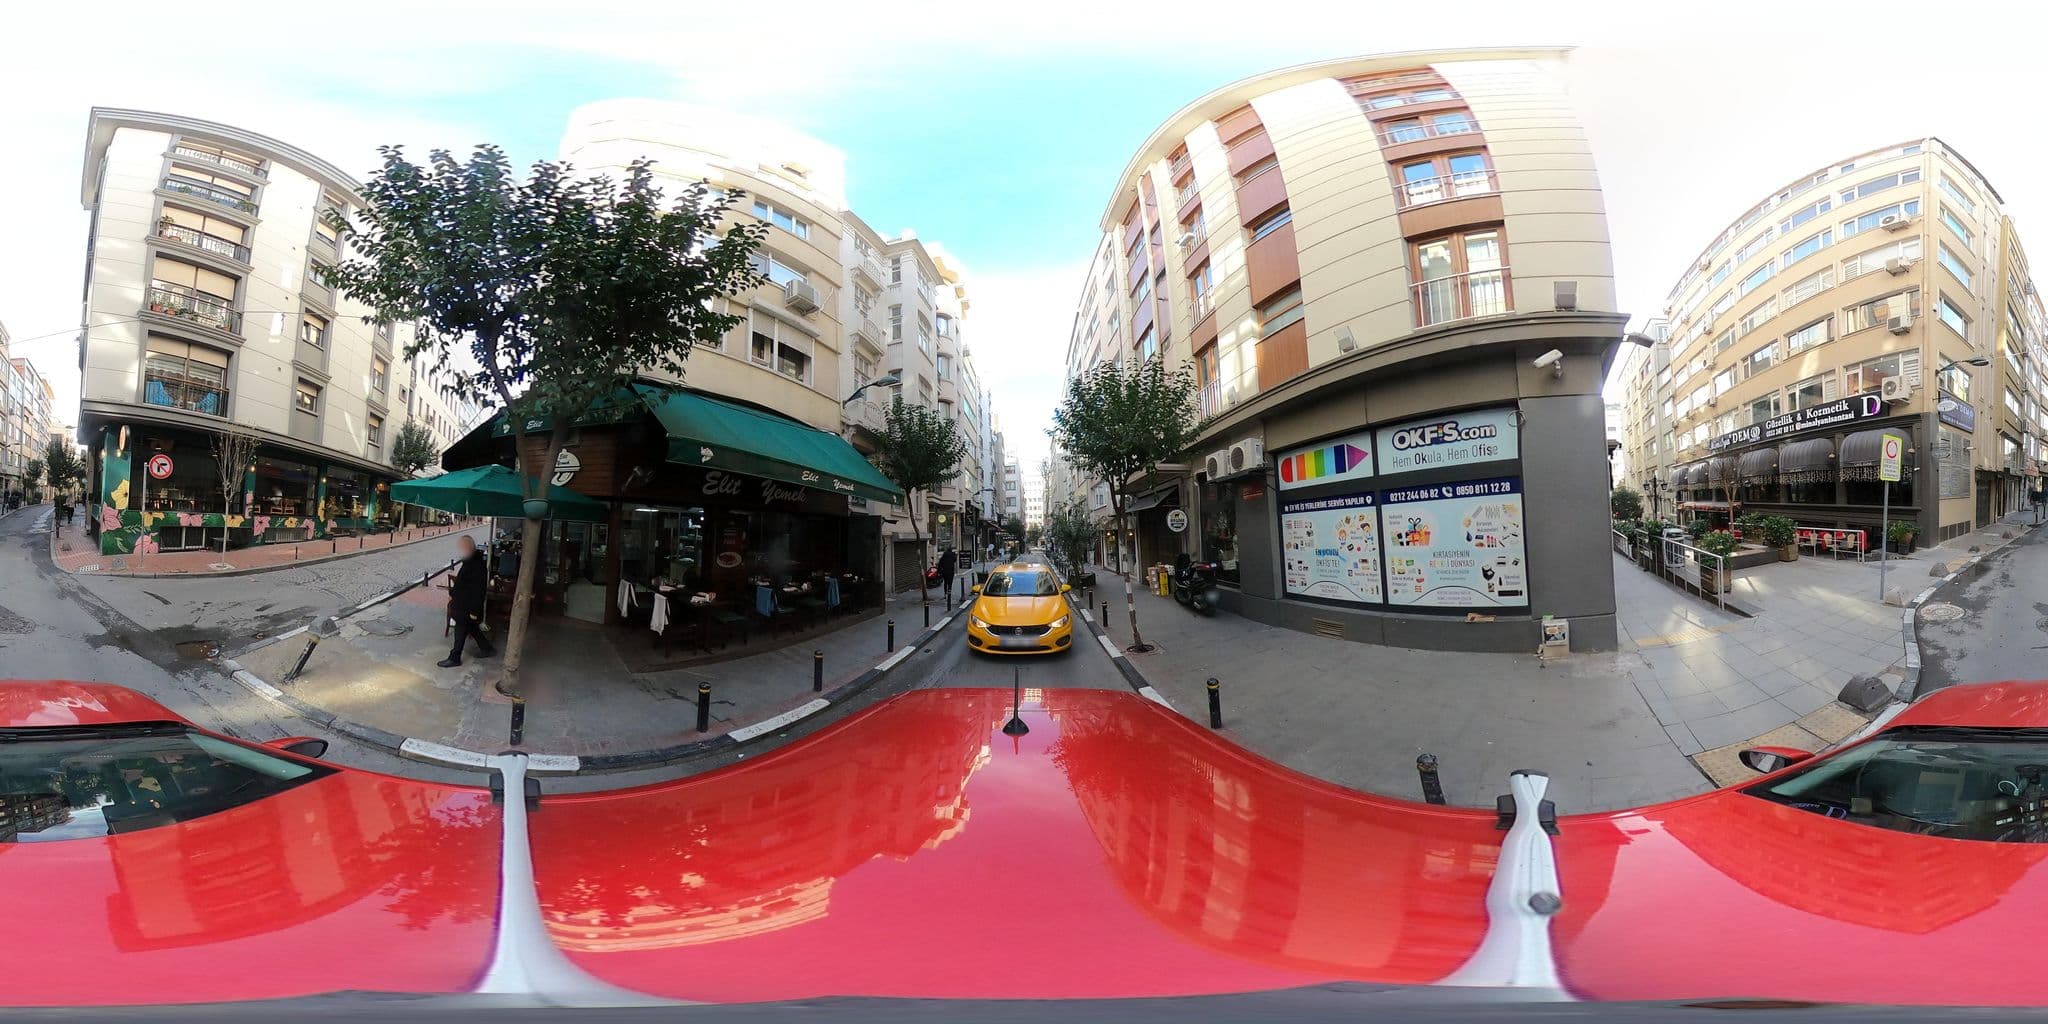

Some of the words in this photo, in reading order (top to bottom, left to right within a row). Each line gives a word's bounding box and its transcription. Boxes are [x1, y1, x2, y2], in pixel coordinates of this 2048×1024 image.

[1765, 414, 1794, 430] Güzellik
[1796, 412, 1802, 422] &
[1806, 400, 1849, 418] Kozmetik
[1392, 455, 1411, 468] Hem
[1414, 452, 1445, 465] Okula,
[1447, 447, 1469, 461] Hem
[702, 471, 742, 496] Elit
[760, 480, 809, 504] Yemek
[801, 470, 819, 482] Elit
[832, 478, 856, 492] Yemek
[1389, 491, 1405, 502] 0212
[1406, 490, 1419, 501] 244
[1419, 489, 1429, 499] 06
[1429, 488, 1439, 498] 82
[1456, 485, 1474, 496] 0850
[1475, 483, 1488, 494] 811
[1490, 482, 1499, 493] 12
[1500, 481, 1511, 492] 28
